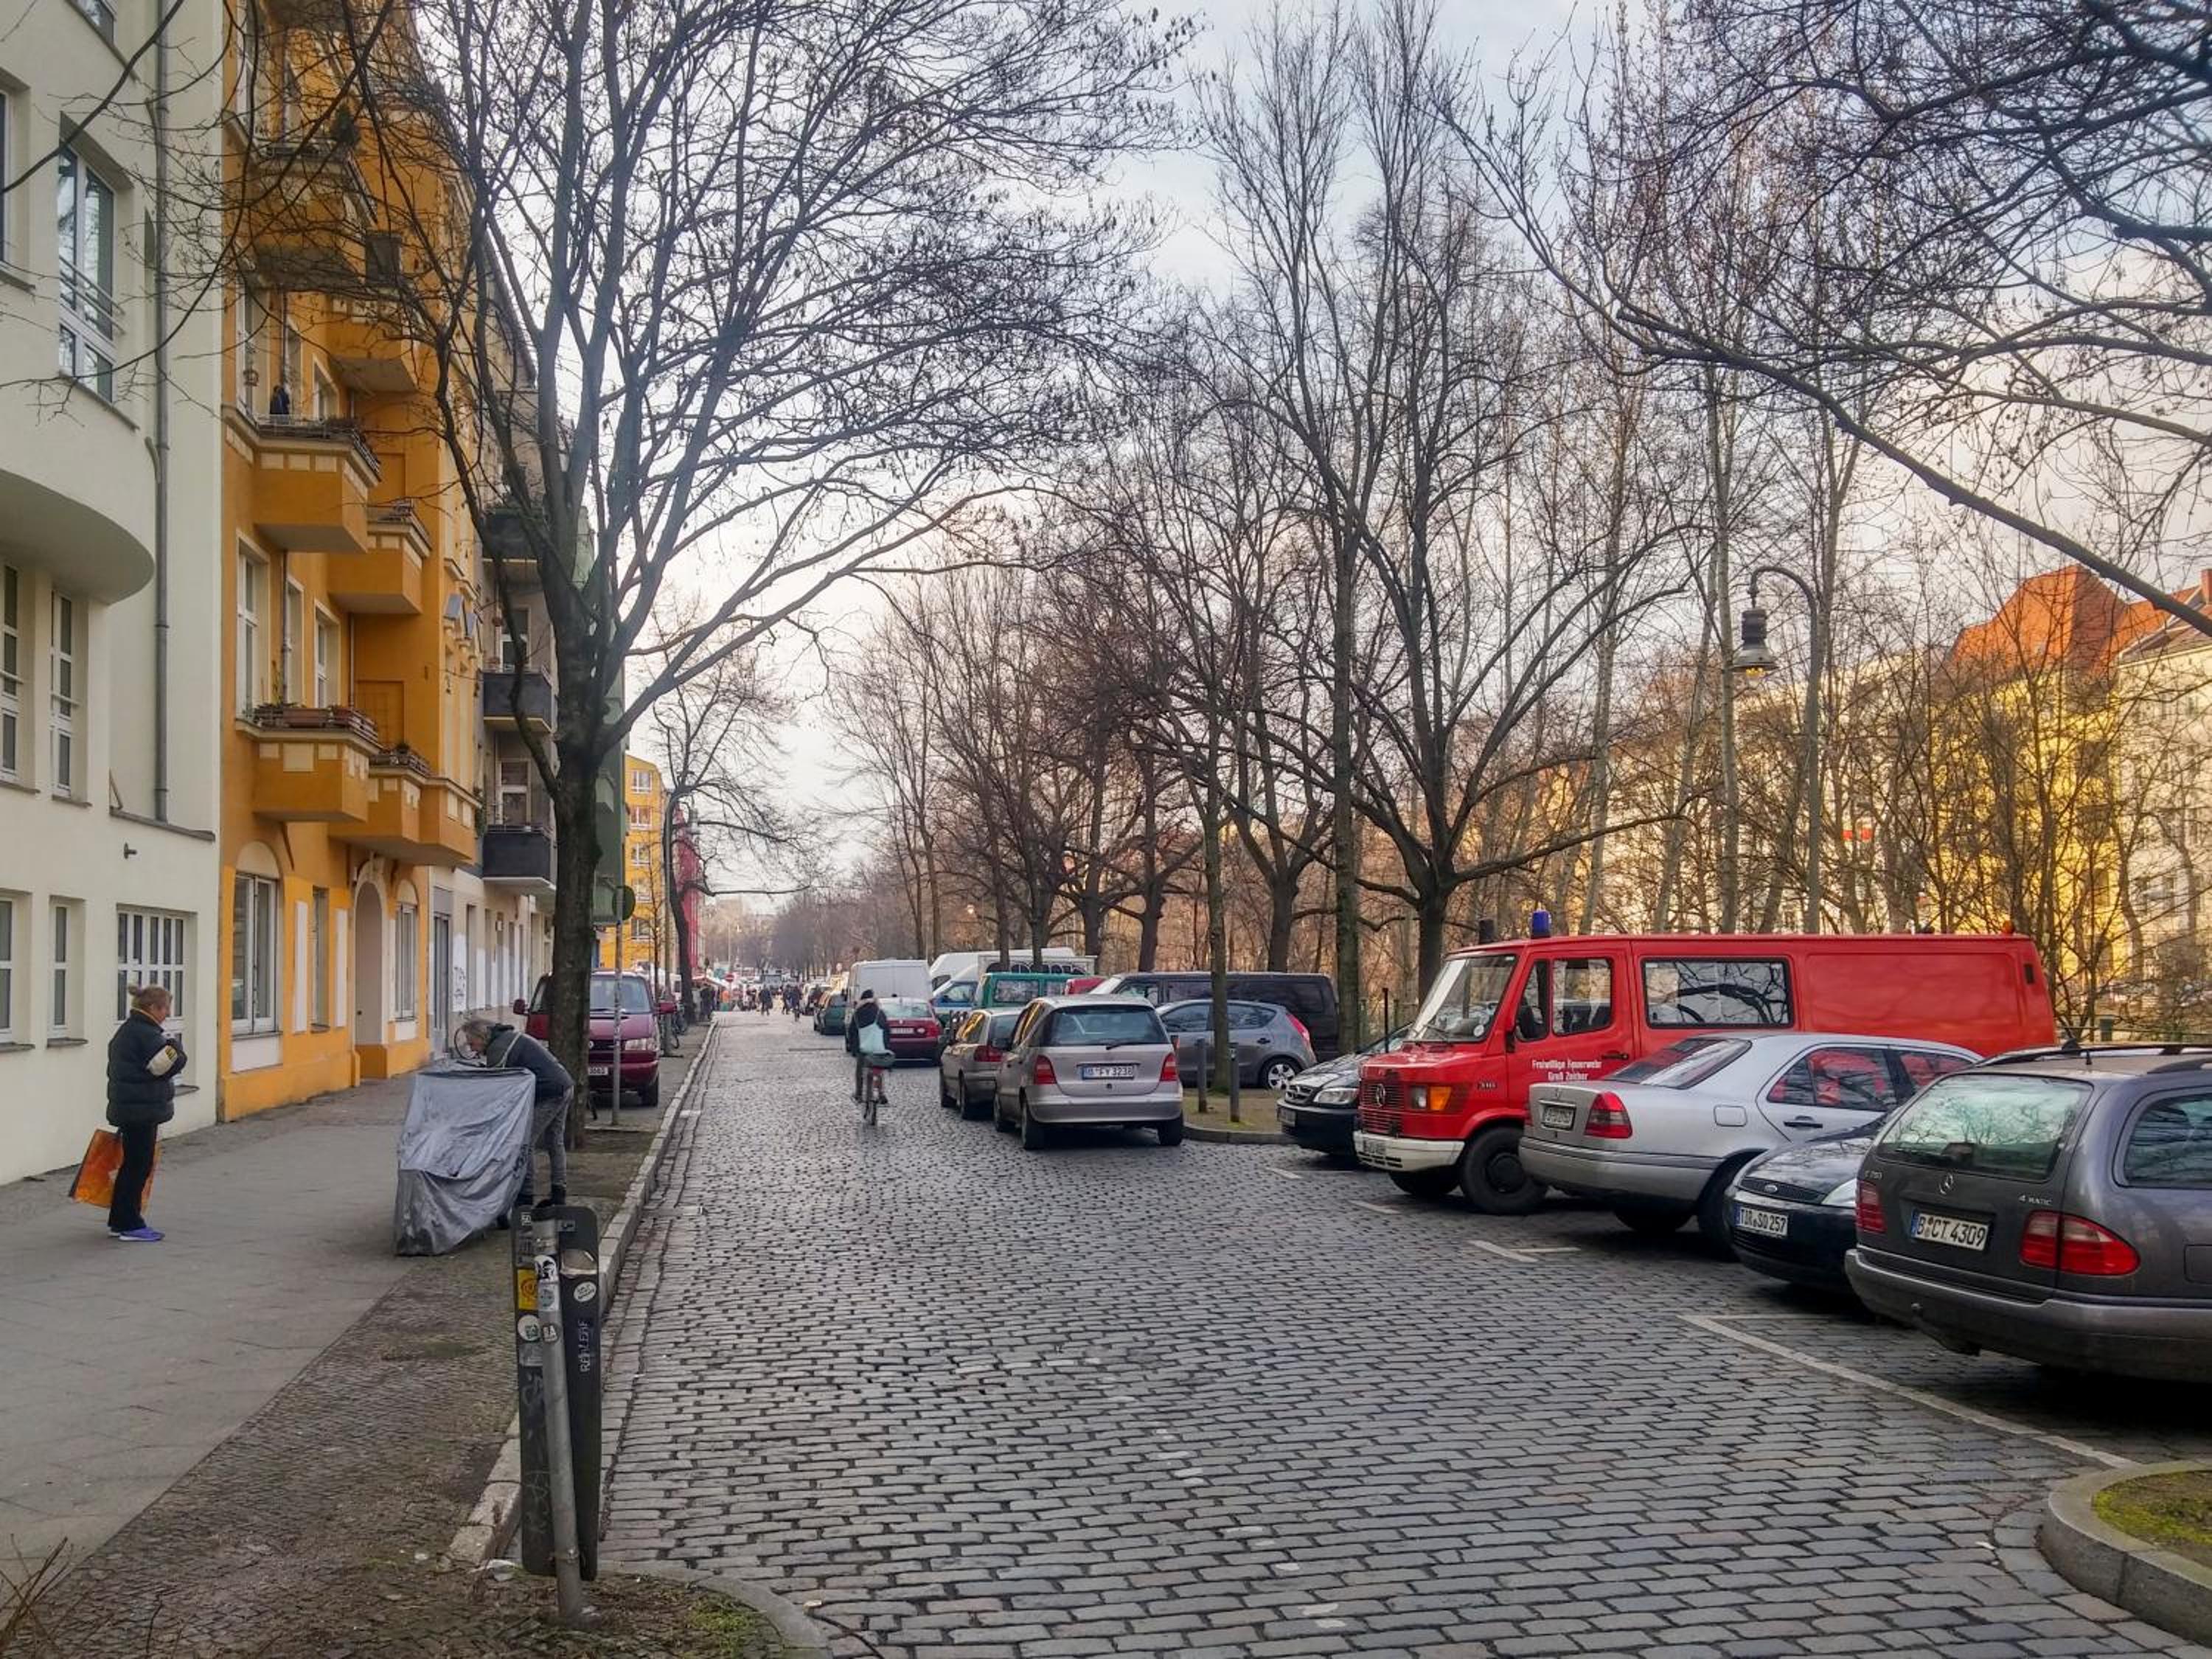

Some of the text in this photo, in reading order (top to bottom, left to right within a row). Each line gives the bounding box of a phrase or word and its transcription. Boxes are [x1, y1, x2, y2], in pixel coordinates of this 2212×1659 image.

[1770, 1214, 1787, 1234] 257
[1917, 1216, 1986, 1248] B CT 4309
